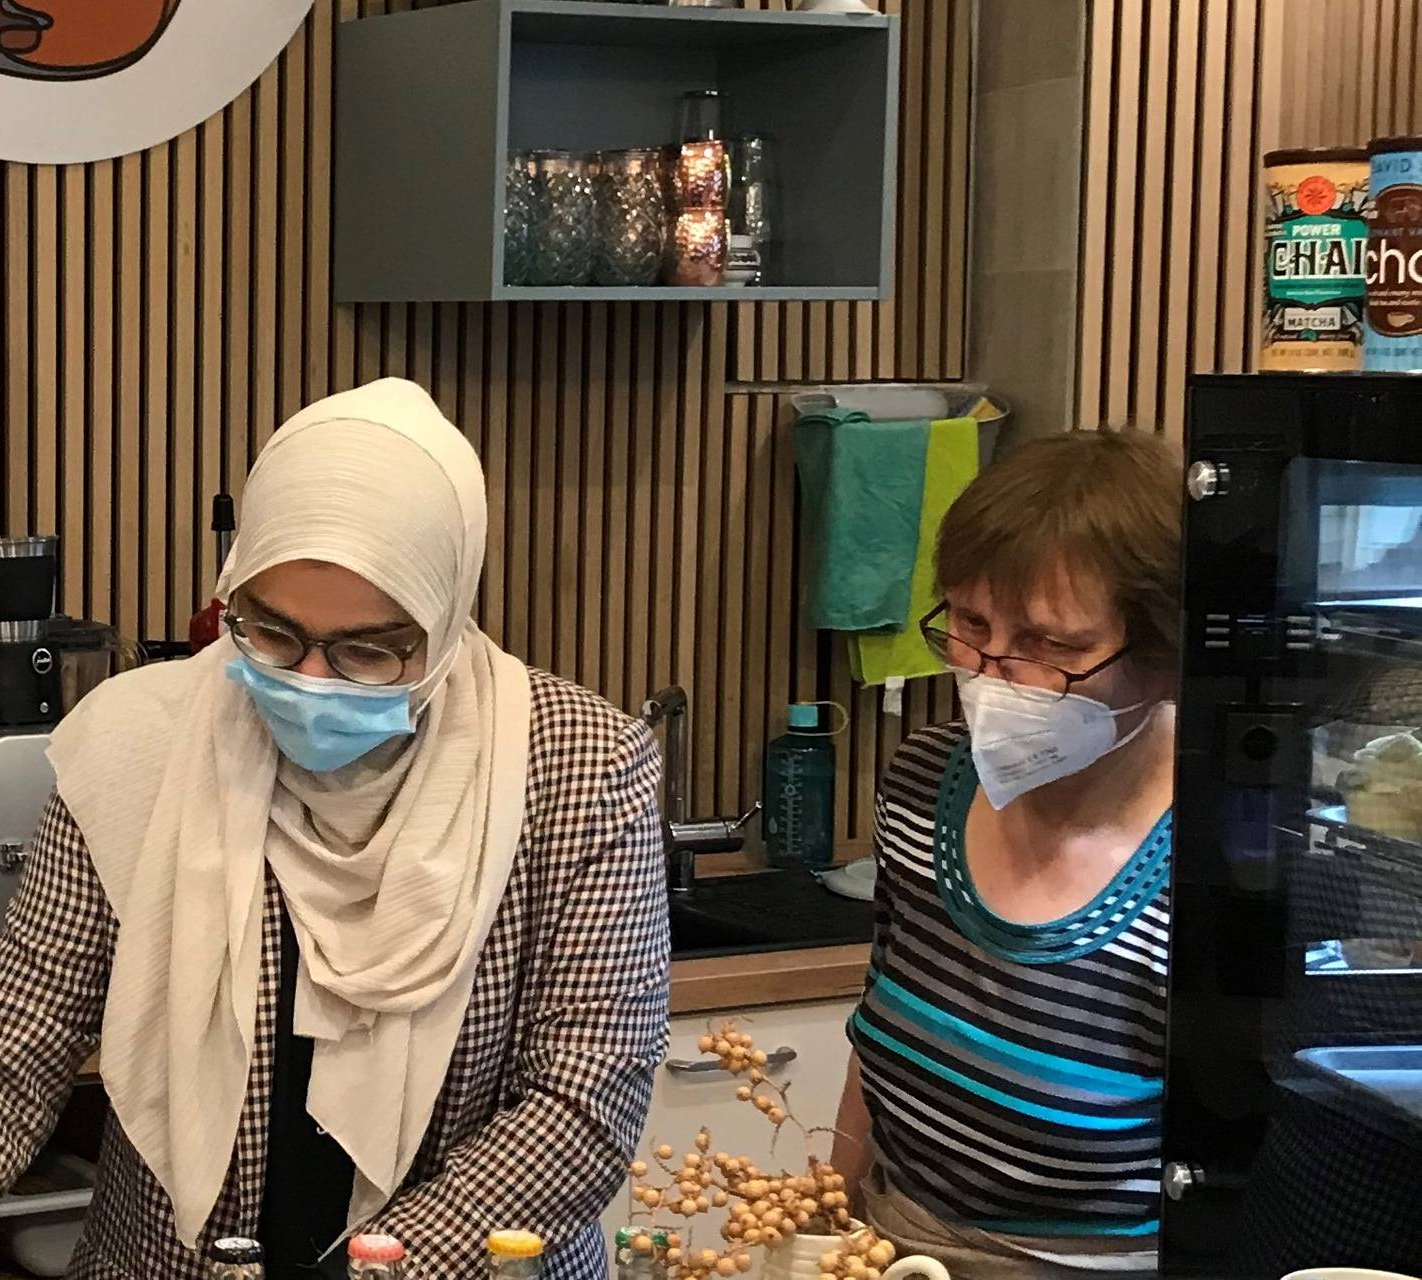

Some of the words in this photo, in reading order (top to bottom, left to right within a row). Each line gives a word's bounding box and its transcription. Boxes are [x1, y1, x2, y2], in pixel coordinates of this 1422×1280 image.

[1291, 223, 1342, 237] POWER
[1272, 238, 1368, 280] CHAI
[1287, 316, 1337, 329] MATCHA
